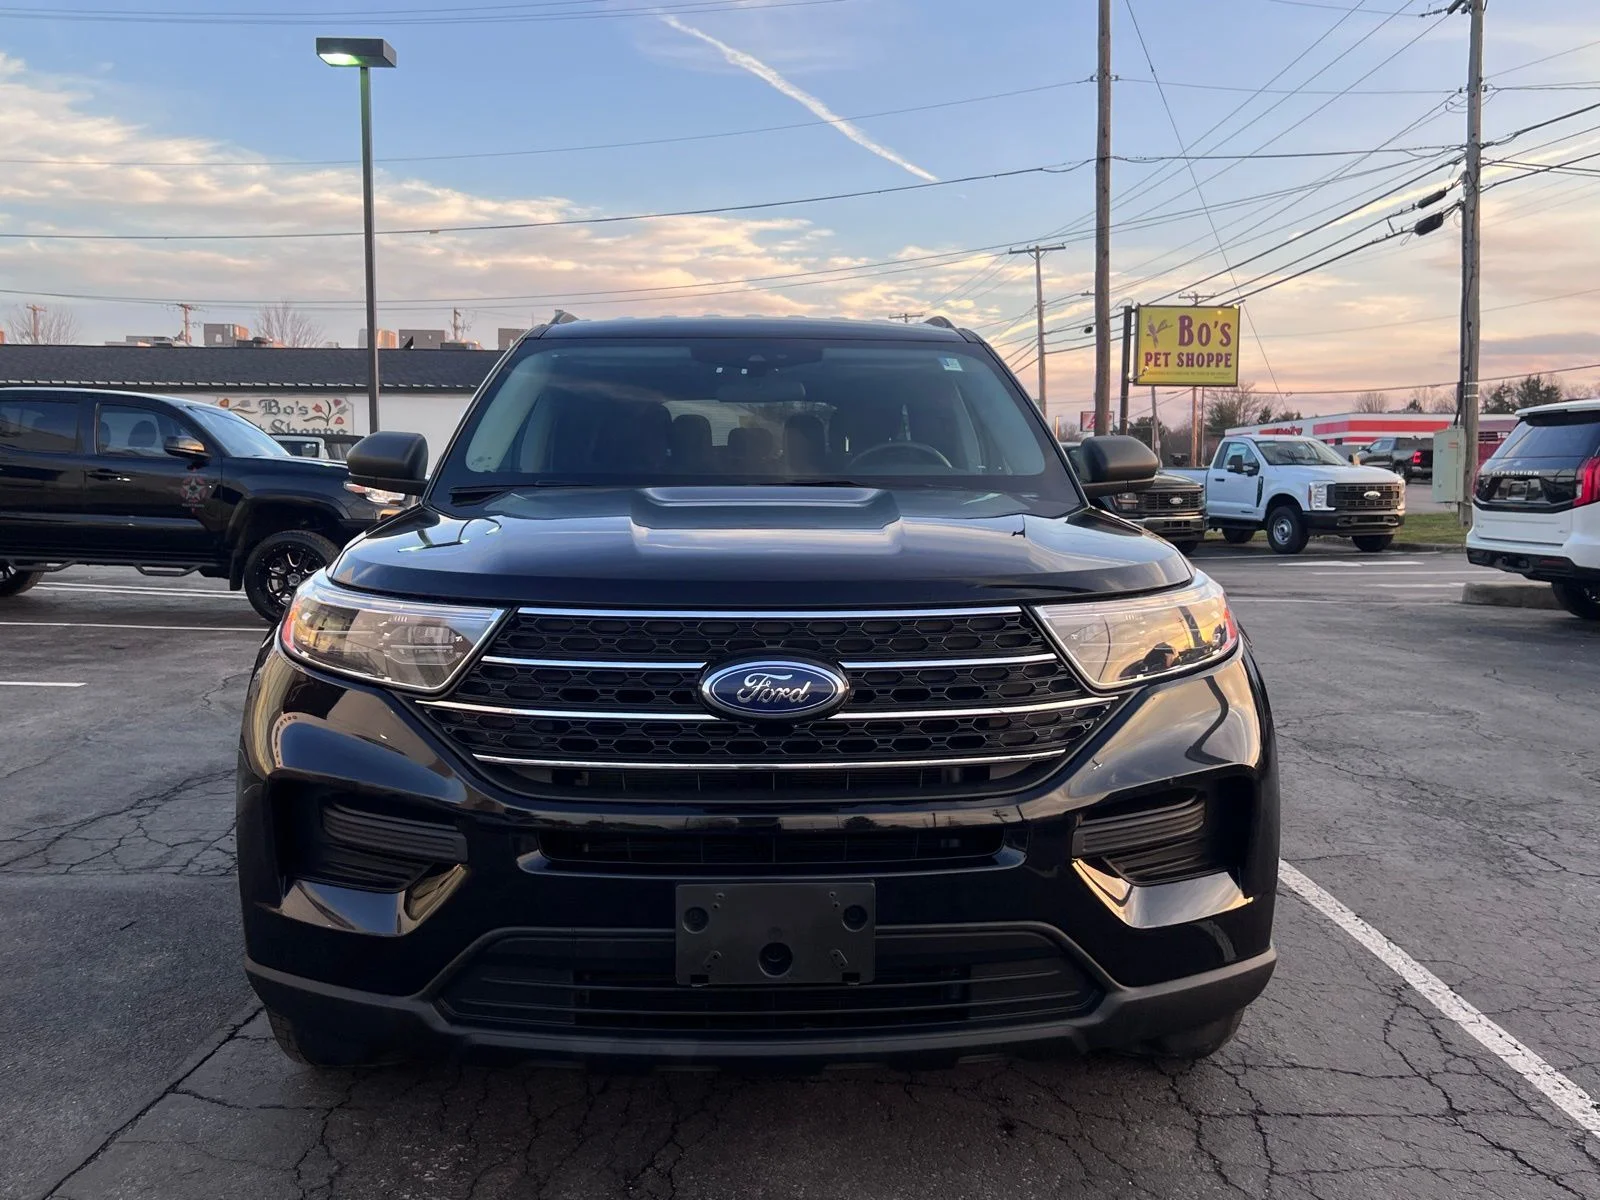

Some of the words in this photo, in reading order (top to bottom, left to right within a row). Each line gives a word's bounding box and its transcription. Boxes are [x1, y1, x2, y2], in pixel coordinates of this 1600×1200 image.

[1144, 351, 1171, 368] PET
[1176, 351, 1233, 368] SHOPPE
[259, 399, 309, 415] Bo's
[736, 672, 811, 703] Ford
